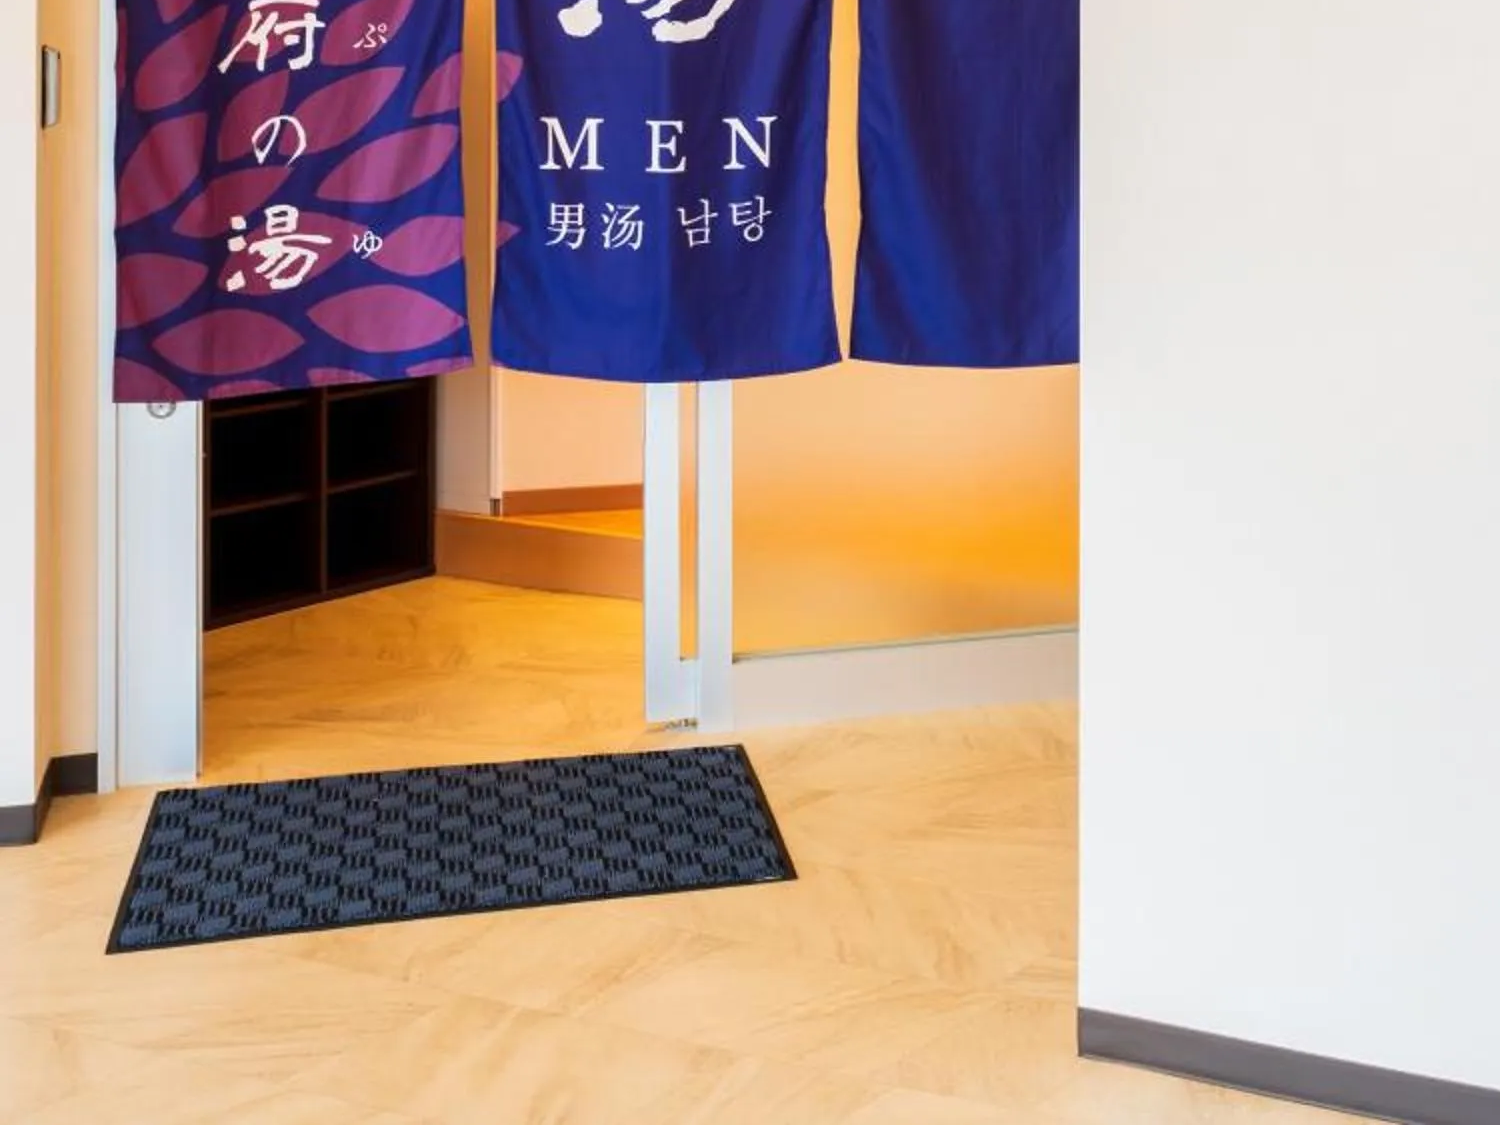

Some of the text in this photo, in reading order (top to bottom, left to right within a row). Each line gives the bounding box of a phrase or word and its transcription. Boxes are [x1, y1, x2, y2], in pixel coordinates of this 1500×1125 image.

[540, 115, 778, 174] MEN
[352, 230, 383, 259] ゆ
[545, 201, 644, 251] 男汤
[677, 195, 772, 248] 남탕
